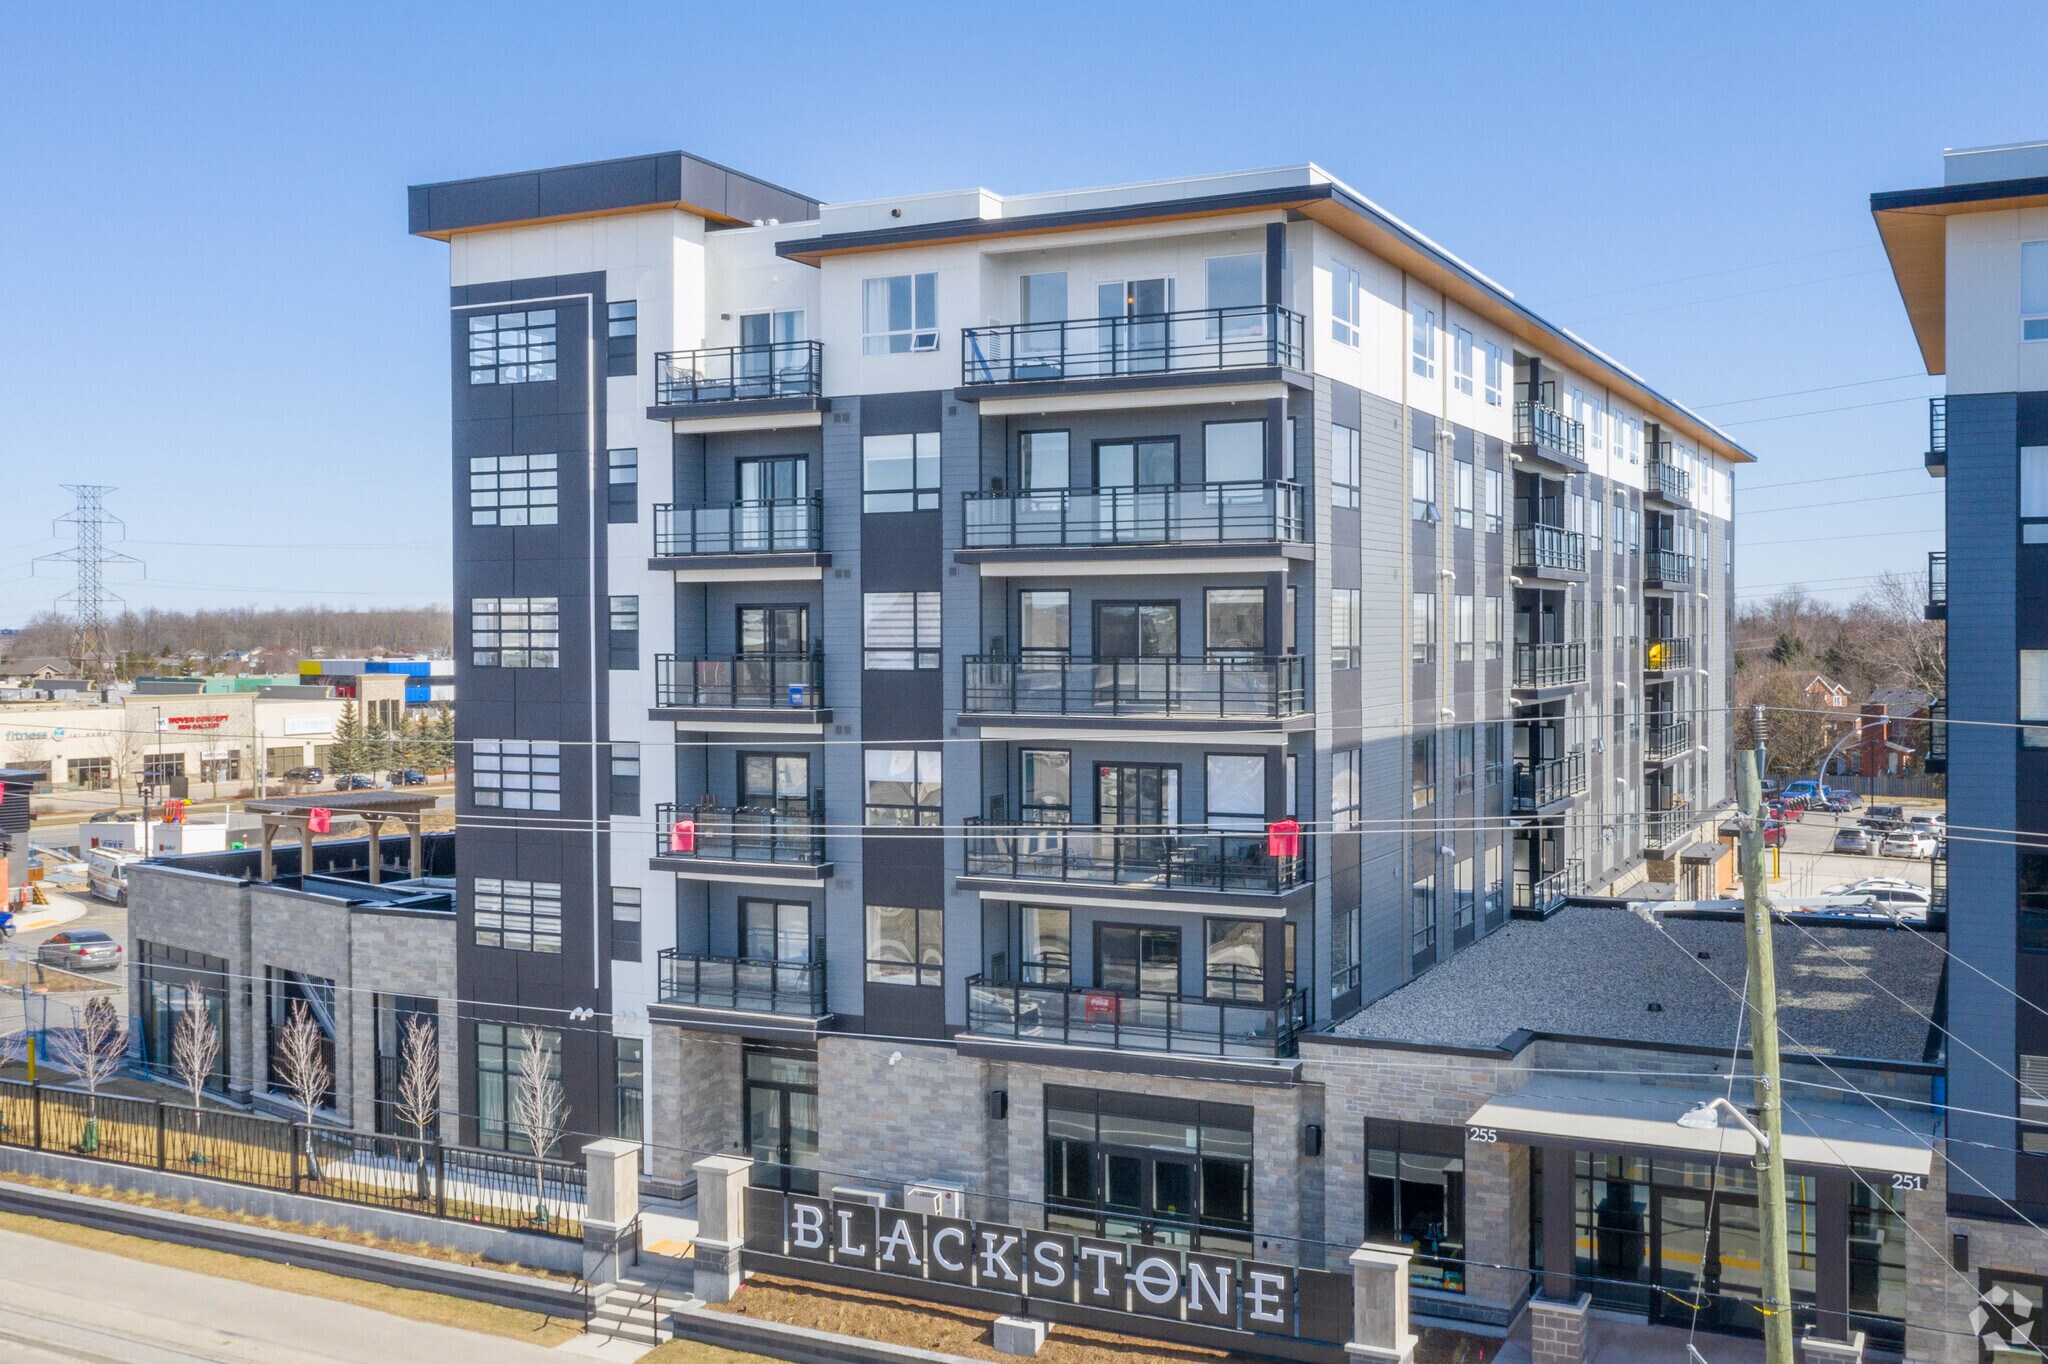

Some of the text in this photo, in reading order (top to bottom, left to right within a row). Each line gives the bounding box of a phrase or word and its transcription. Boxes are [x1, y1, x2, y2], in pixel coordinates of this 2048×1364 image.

[168, 716, 195, 724] WOVEN
[196, 715, 229, 723] CONCEPT
[5, 731, 48, 741] fitness
[1470, 1127, 1497, 1143] 255
[1892, 1174, 1924, 1191] 251
[793, 1202, 1285, 1324] BLACKSTONE
